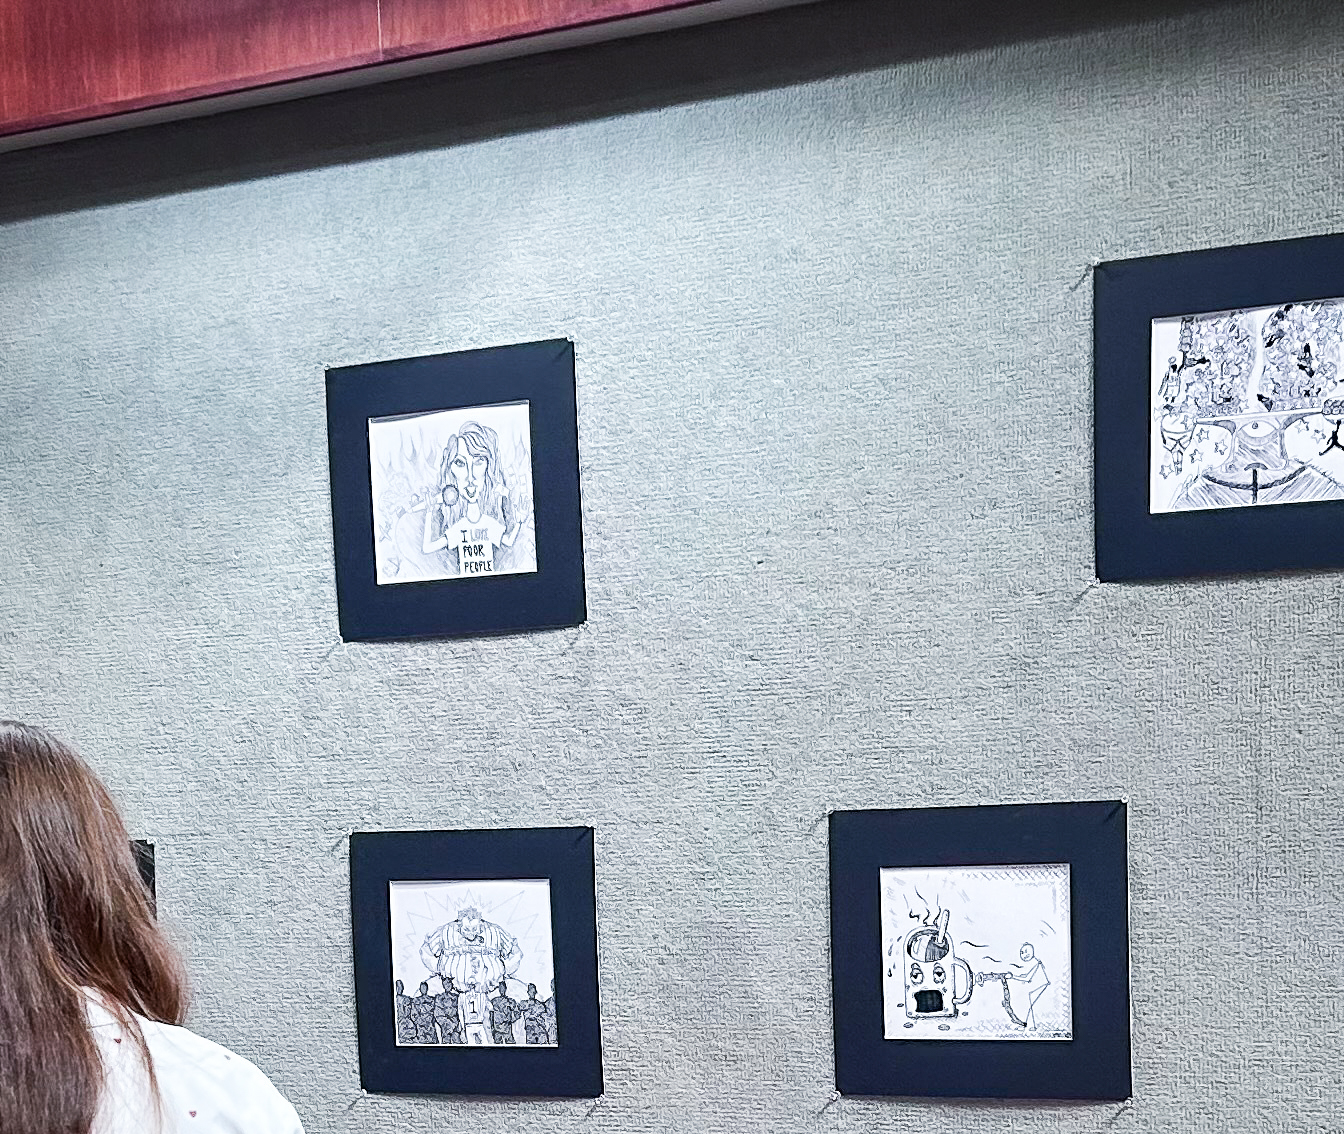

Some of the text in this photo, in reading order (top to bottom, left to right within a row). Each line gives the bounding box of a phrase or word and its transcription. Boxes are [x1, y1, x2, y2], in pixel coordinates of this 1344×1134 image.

[460, 529, 468, 543] I
[463, 544, 485, 558] POOR
[464, 560, 493, 573] PEOPLE
